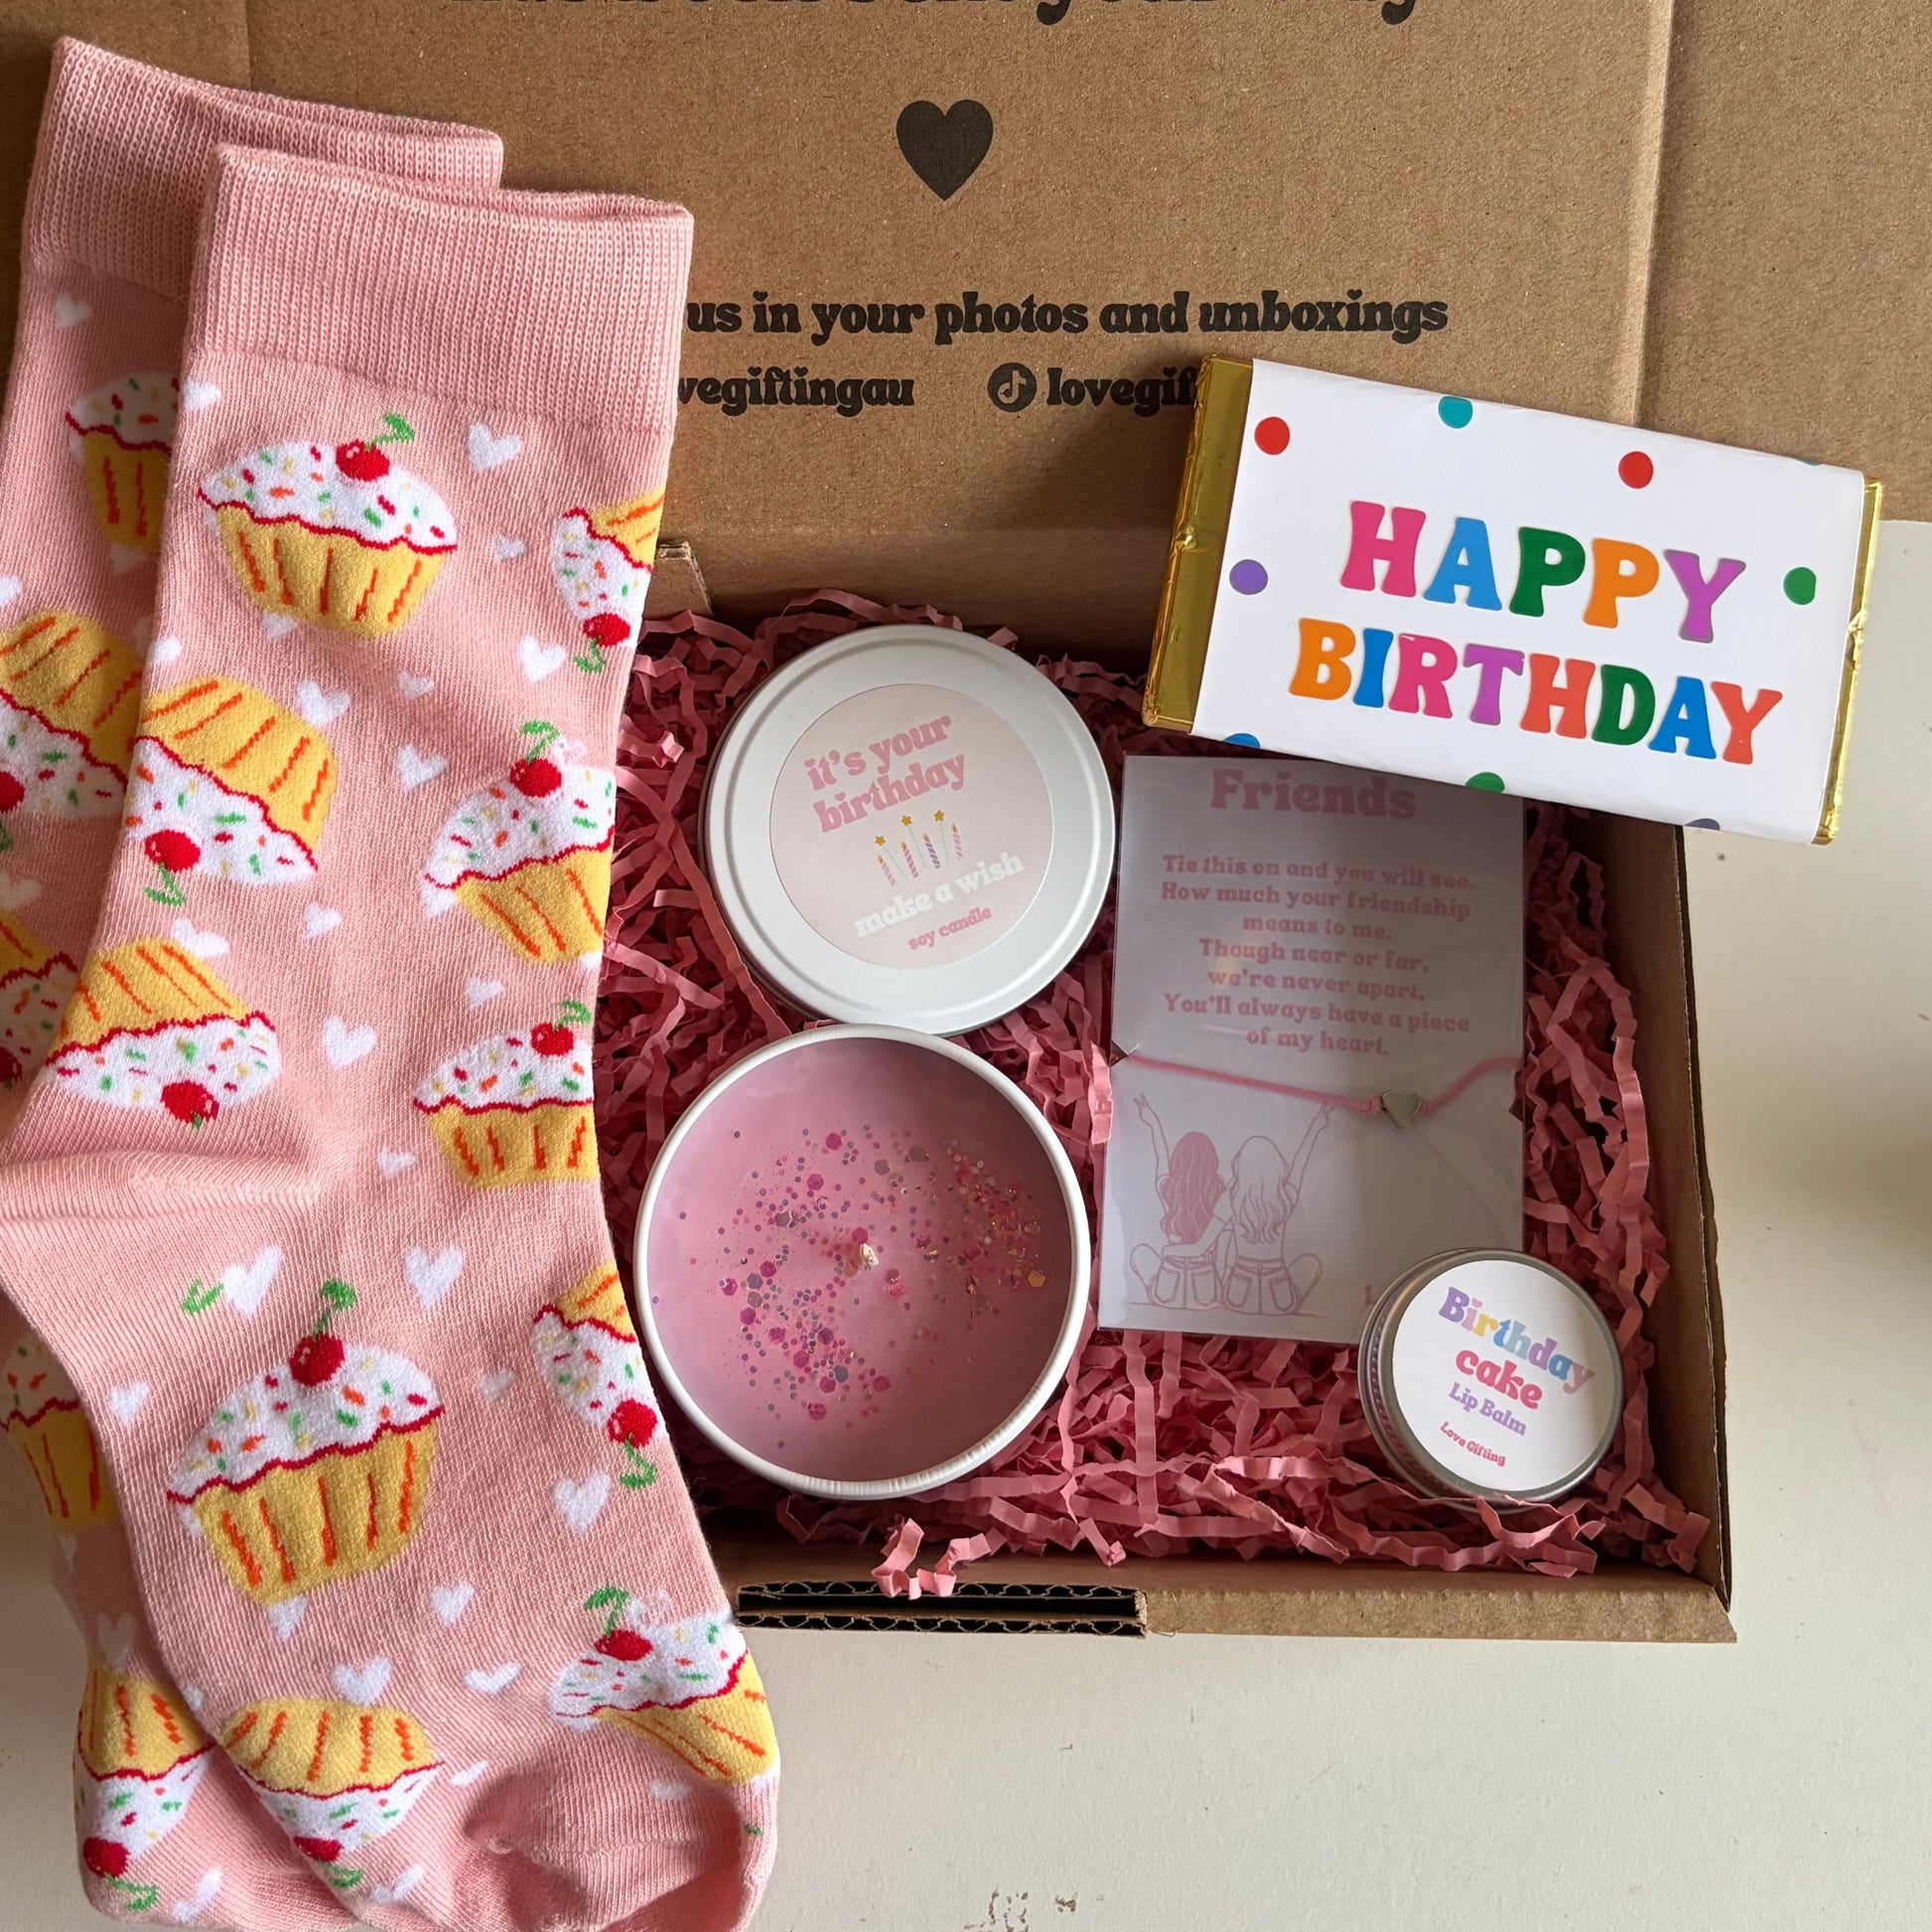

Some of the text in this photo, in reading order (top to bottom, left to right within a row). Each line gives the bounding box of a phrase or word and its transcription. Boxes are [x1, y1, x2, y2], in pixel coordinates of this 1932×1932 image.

[686, 289, 1449, 346] us in your photos and unboxings
[677, 365, 915, 418] vegiftingau
[1046, 367, 1197, 418] lovegif
[1339, 500, 1746, 643] HAPPY
[1288, 618, 1783, 764] BIRTHDAY
[803, 715, 952, 791] it's your
[812, 755, 966, 833] birthday
[1210, 768, 1418, 819] Friends
[853, 851, 1025, 938] make a wish
[1163, 855, 1198, 874] Tie
[1202, 856, 1246, 875] this
[1252, 861, 1281, 877] on
[1287, 861, 1329, 879] and
[1333, 867, 1375, 885] you
[1381, 867, 1426, 887] will
[1162, 882, 1470, 922] How much your friendship
[908, 905, 993, 951] soy candle
[1198, 938, 1286, 965] Though
[1292, 947, 1346, 964] near
[1352, 952, 1379, 967] or
[1242, 916, 1393, 940] means to me.
[1207, 968, 1276, 988] we're
[1282, 975, 1351, 993] never
[1164, 994, 1470, 1035] You'll always have a piece
[1246, 1027, 1389, 1054] of my heart.
[1439, 1286, 1596, 1395] Birthday
[1454, 1349, 1544, 1410] cake
[1448, 1381, 1527, 1437] Lip Balm
[1439, 1421, 1507, 1467] Love Gifting
